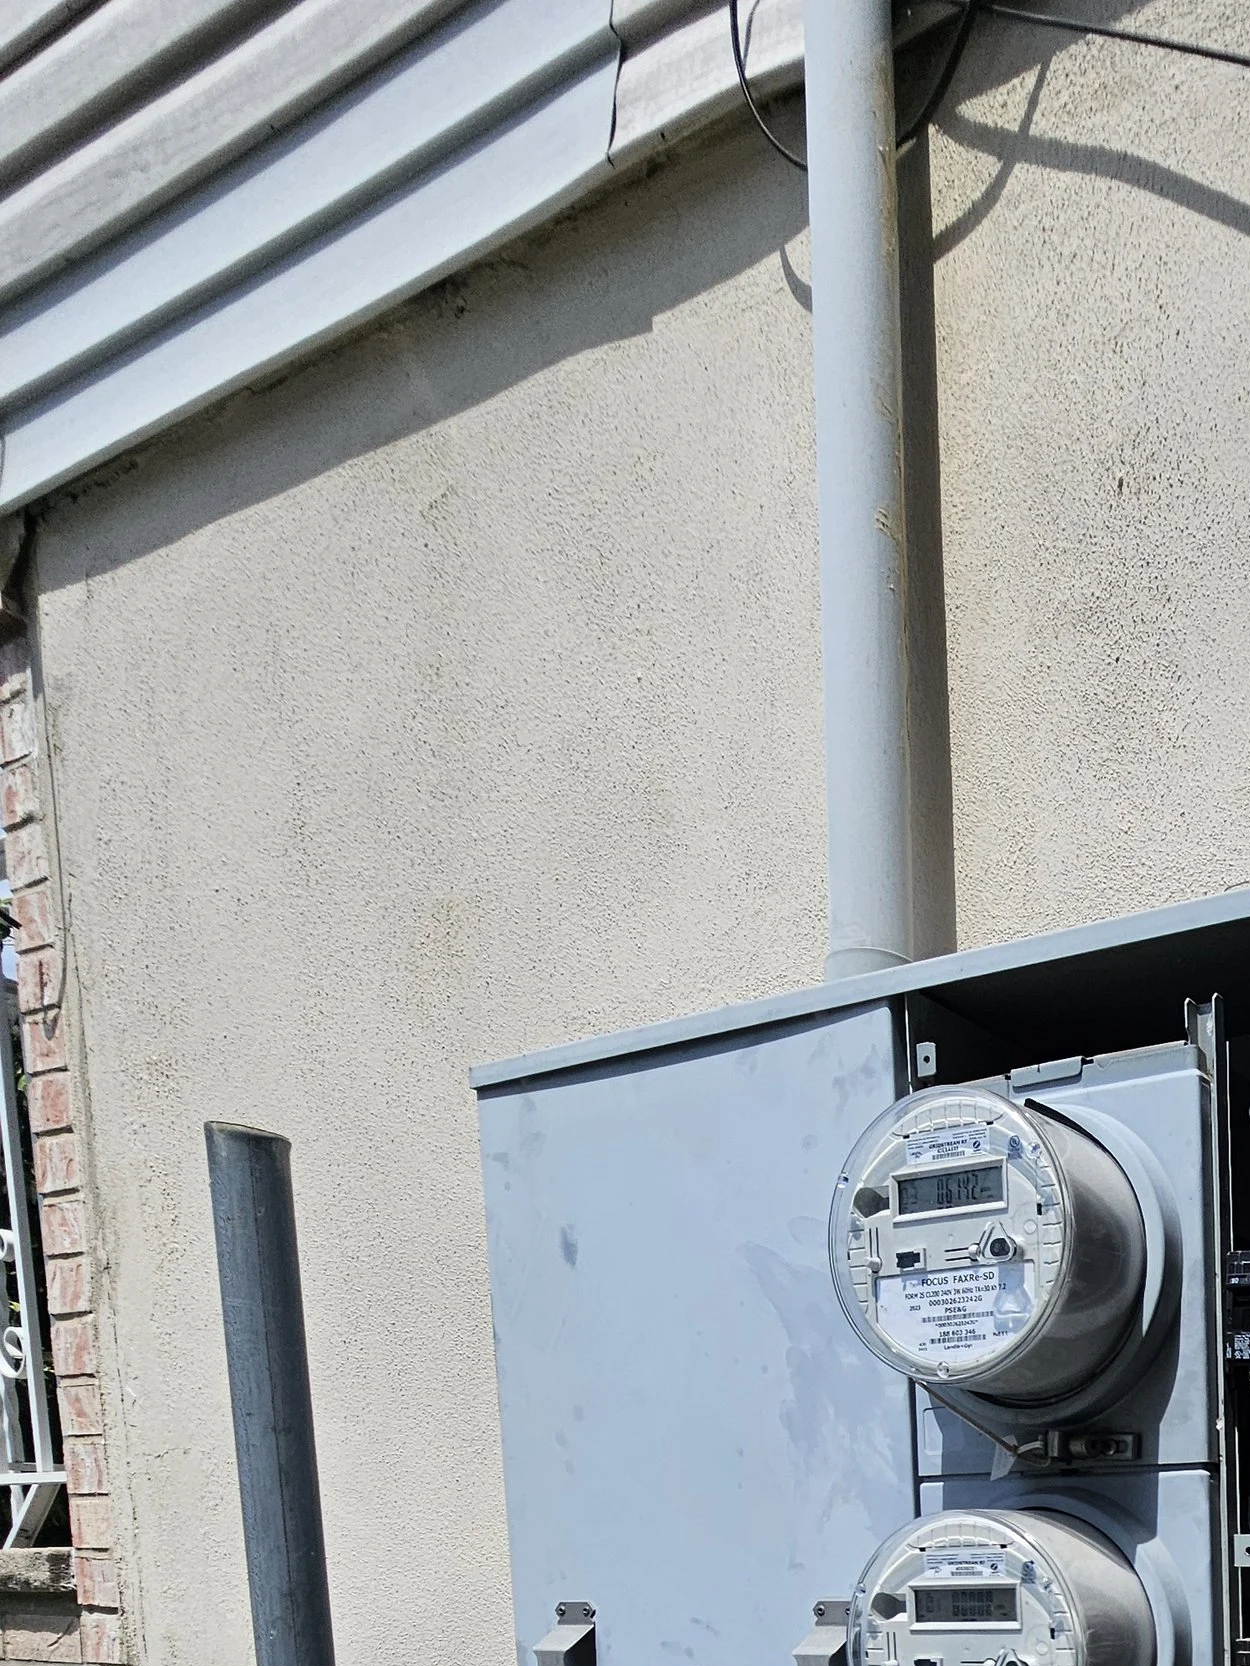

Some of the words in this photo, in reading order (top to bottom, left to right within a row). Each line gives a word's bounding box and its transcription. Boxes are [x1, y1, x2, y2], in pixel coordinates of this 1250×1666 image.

[922, 1277, 948, 1287] FOCUS
[953, 1272, 995, 1284] FAXRe-SD
[945, 1306, 967, 1314] PSE&G
[940, 1330, 951, 1338] 188
[964, 1328, 976, 1336] 346
